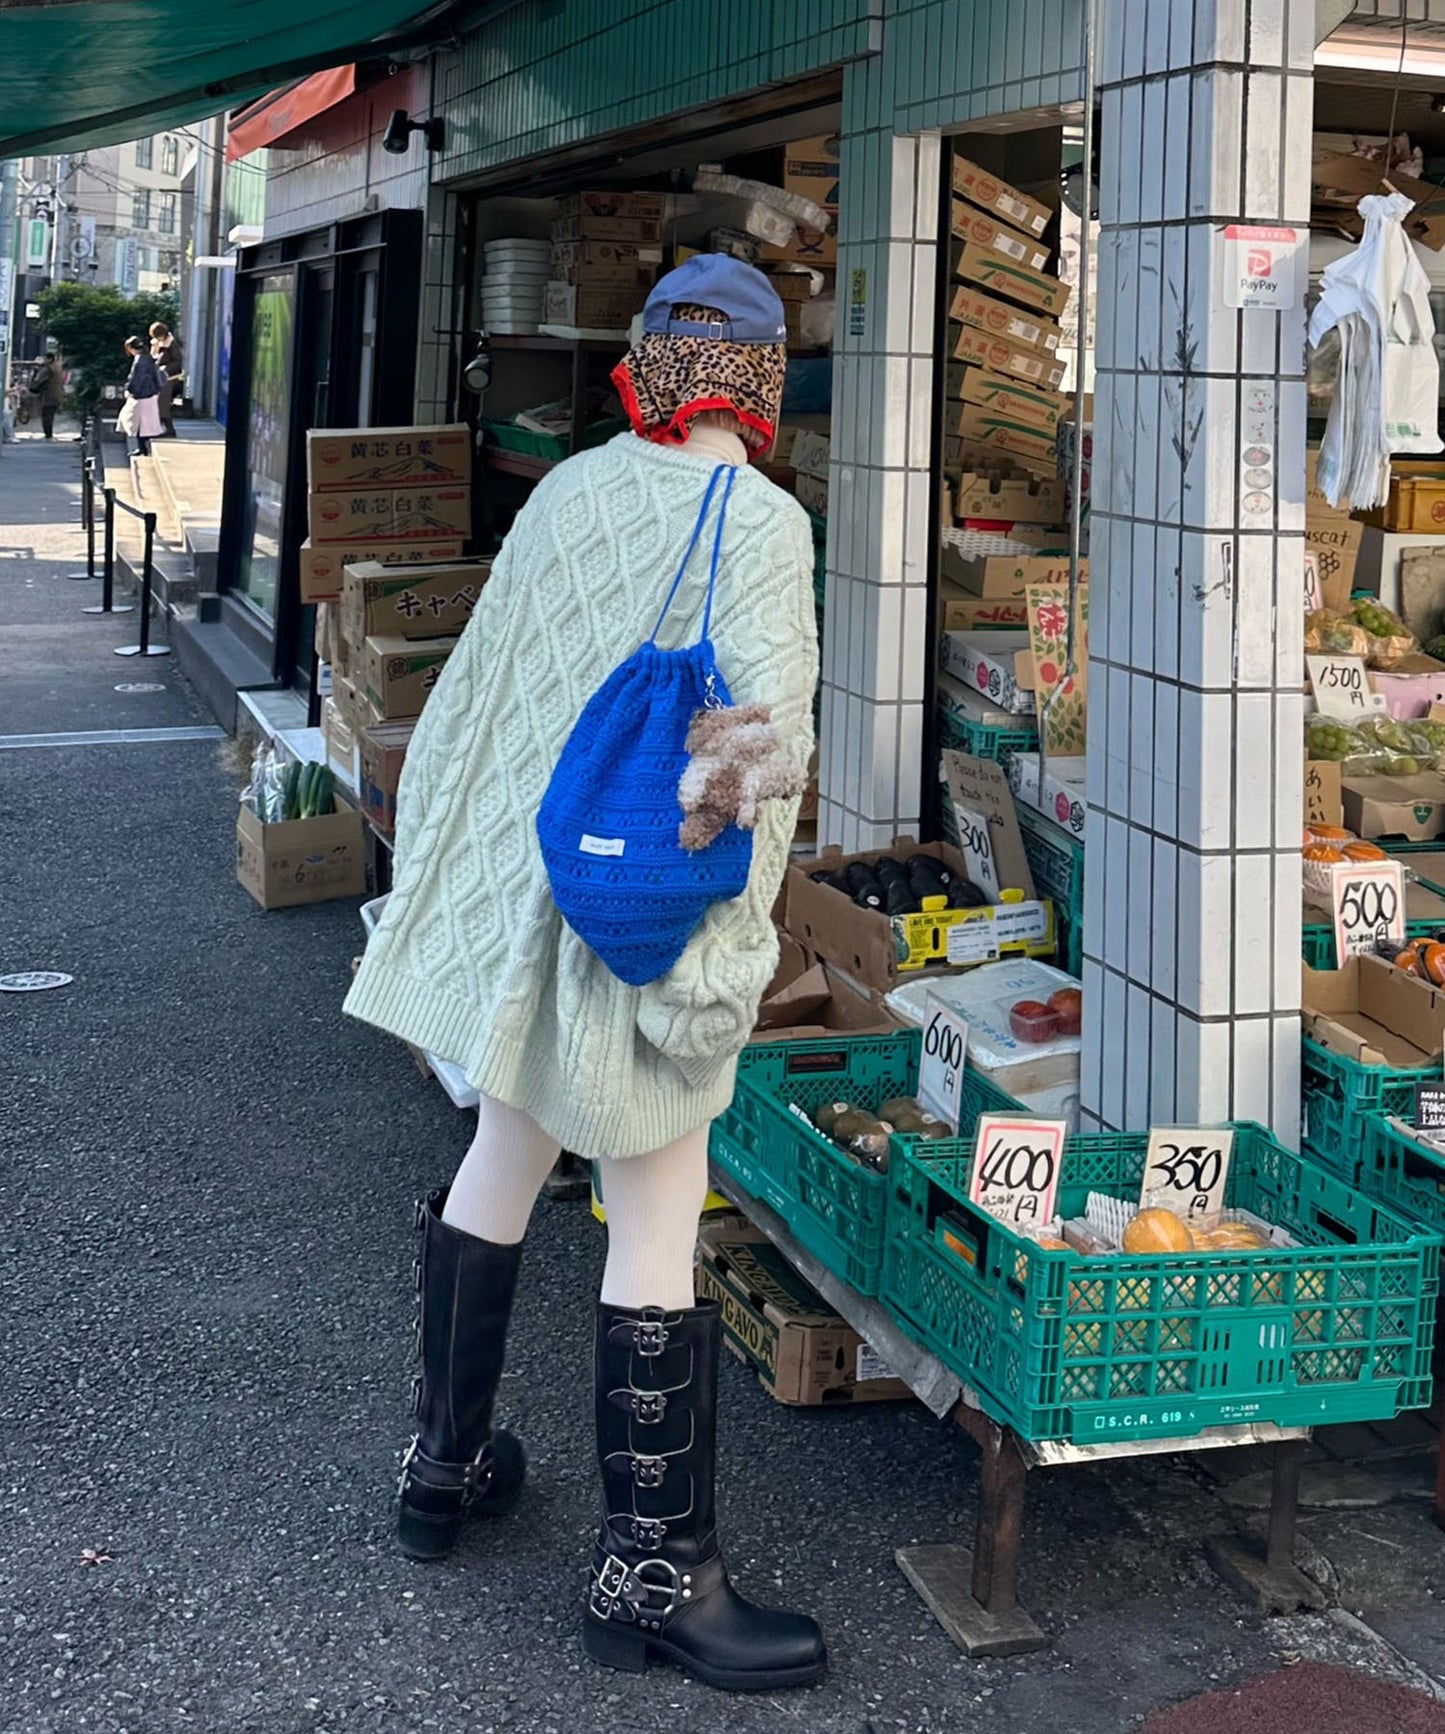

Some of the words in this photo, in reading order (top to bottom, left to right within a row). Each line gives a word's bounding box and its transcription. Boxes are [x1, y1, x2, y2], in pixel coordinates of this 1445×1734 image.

[1240, 279, 1278, 292] PayPay
[351, 439, 434, 459] 黄芯白菜
[351, 495, 434, 515] 黄芯白菜
[1305, 530, 1350, 547] uscat
[1318, 664, 1361, 691] 1500
[960, 816, 989, 859] 300
[1340, 881, 1397, 929] 500
[925, 1012, 963, 1070] 600
[978, 1139, 1054, 1192] 400
[1151, 1144, 1222, 1192] 350
[1161, 1411, 1182, 1424] 619
